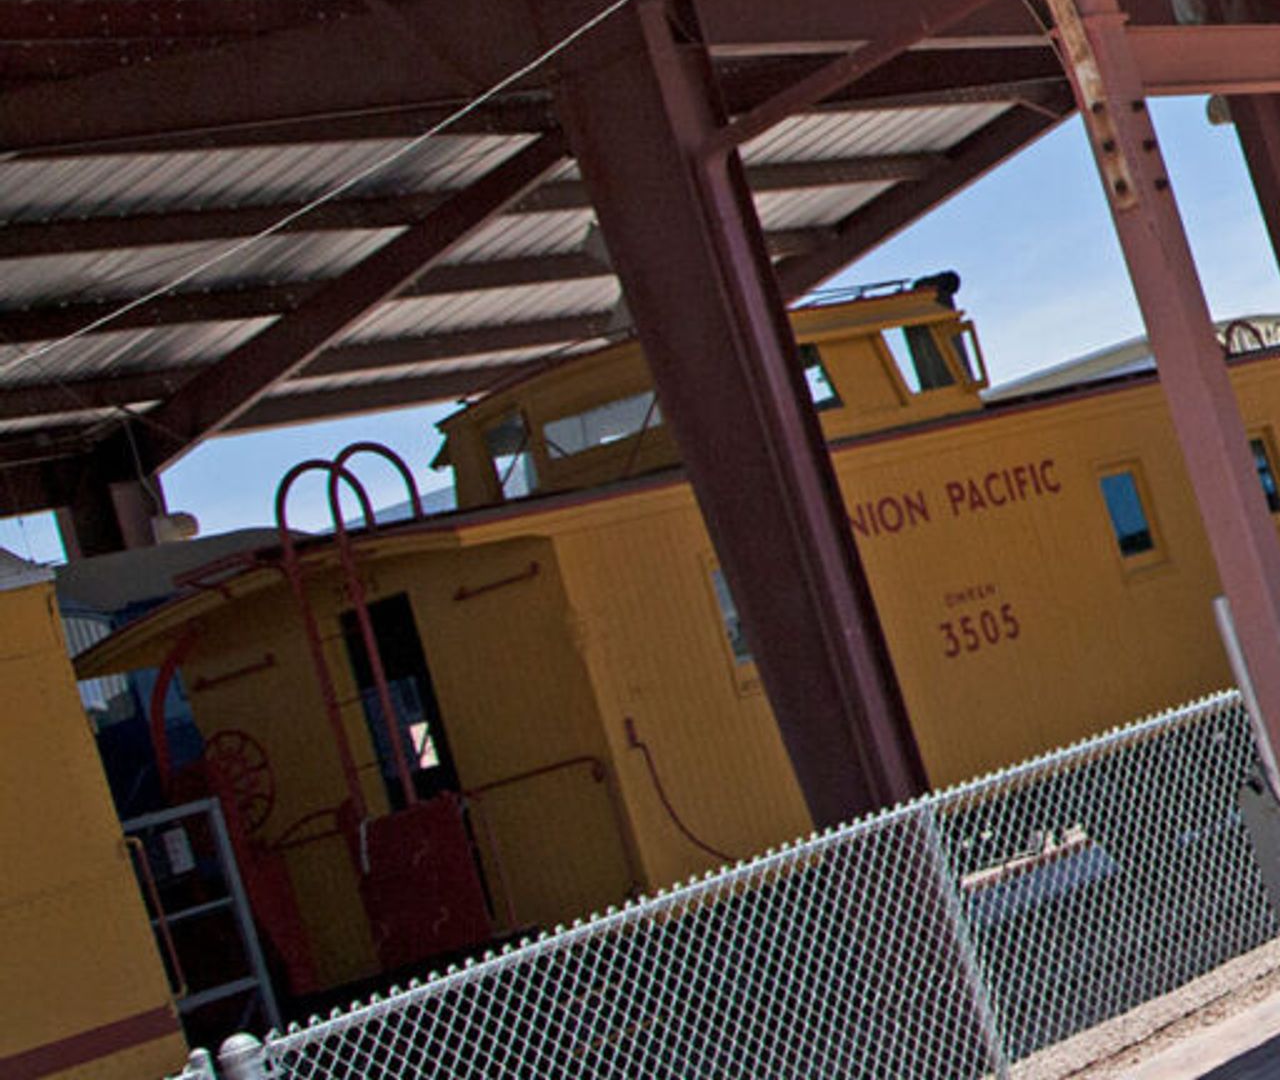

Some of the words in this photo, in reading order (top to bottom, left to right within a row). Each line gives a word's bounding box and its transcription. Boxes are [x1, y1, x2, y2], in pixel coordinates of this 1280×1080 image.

[850, 489, 932, 538] NION
[945, 459, 1062, 517] PACIFIC
[938, 602, 1021, 659] 3505
